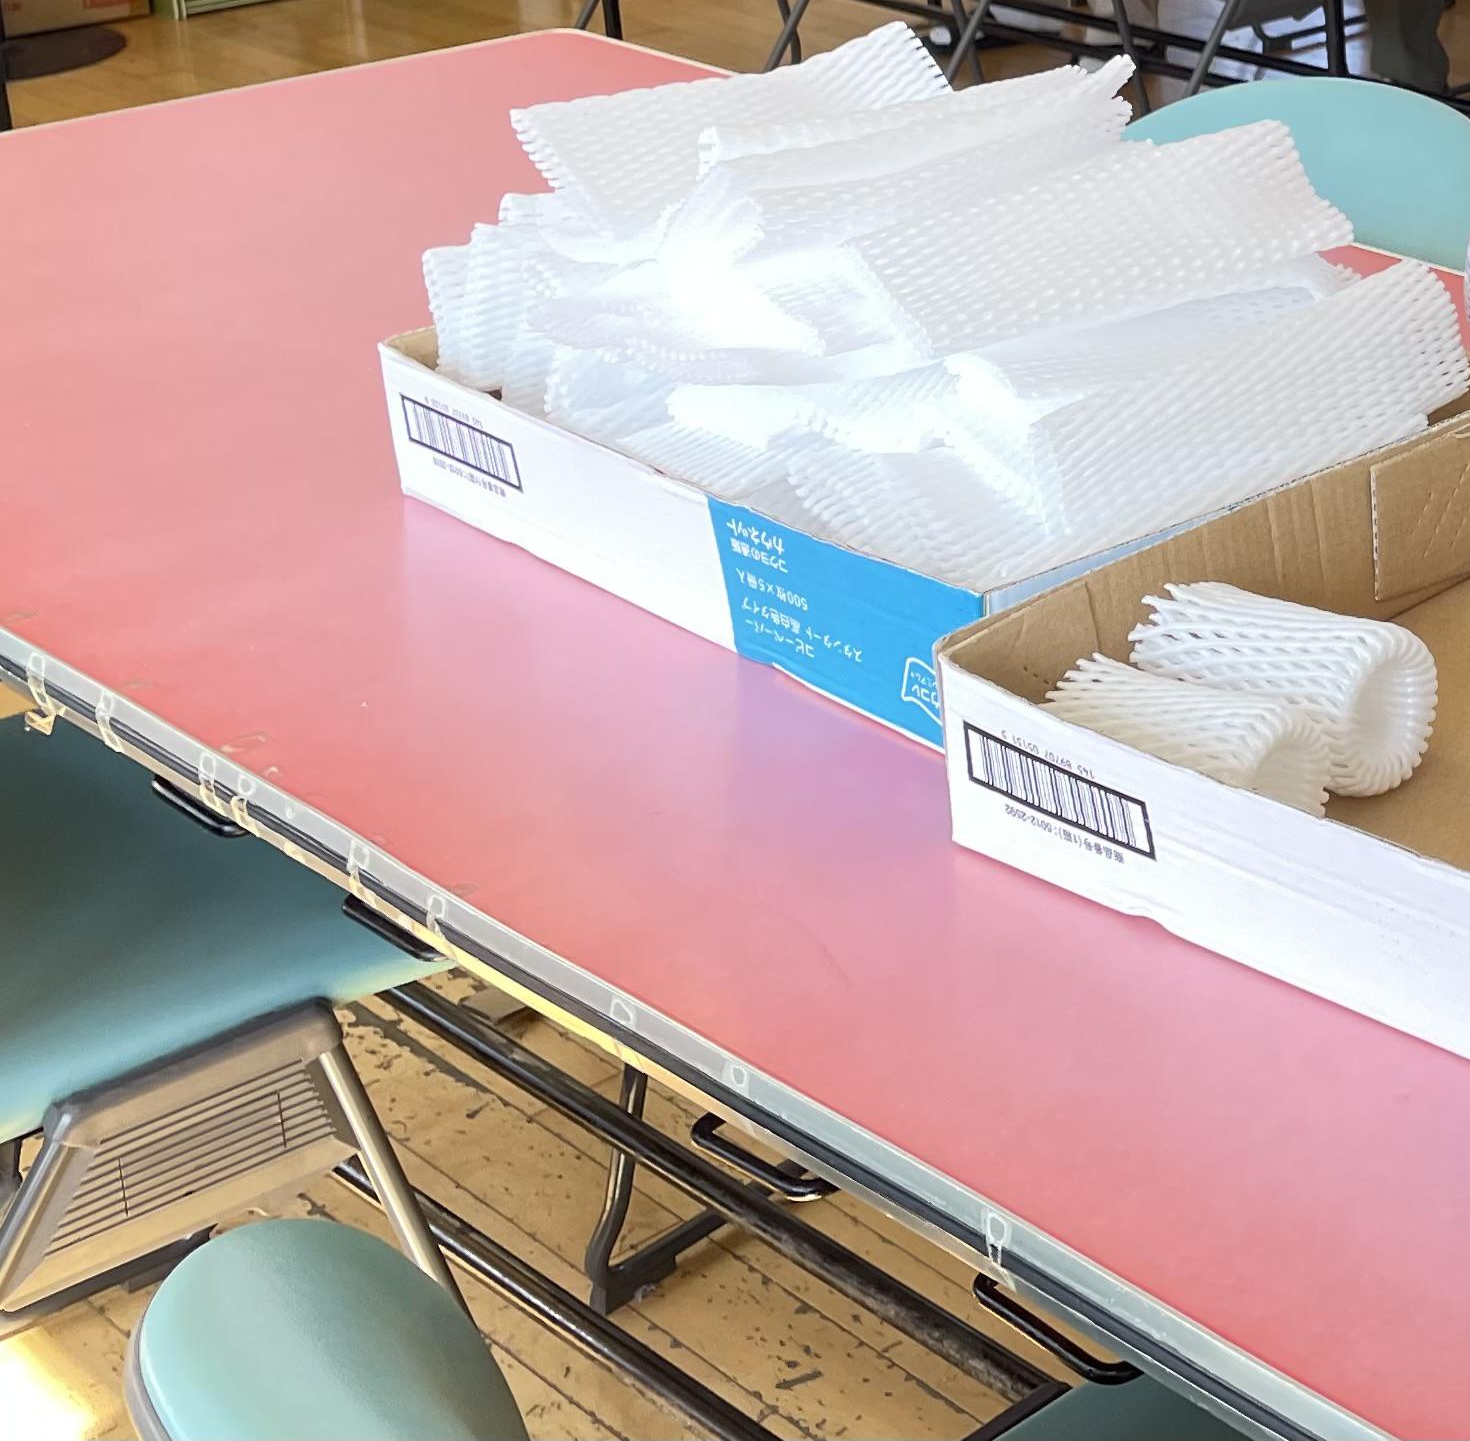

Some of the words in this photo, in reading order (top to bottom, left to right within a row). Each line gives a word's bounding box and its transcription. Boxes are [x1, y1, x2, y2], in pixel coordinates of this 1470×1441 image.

[726, 517, 785, 554] カウネット
[744, 619, 816, 658] コピーペーパー
